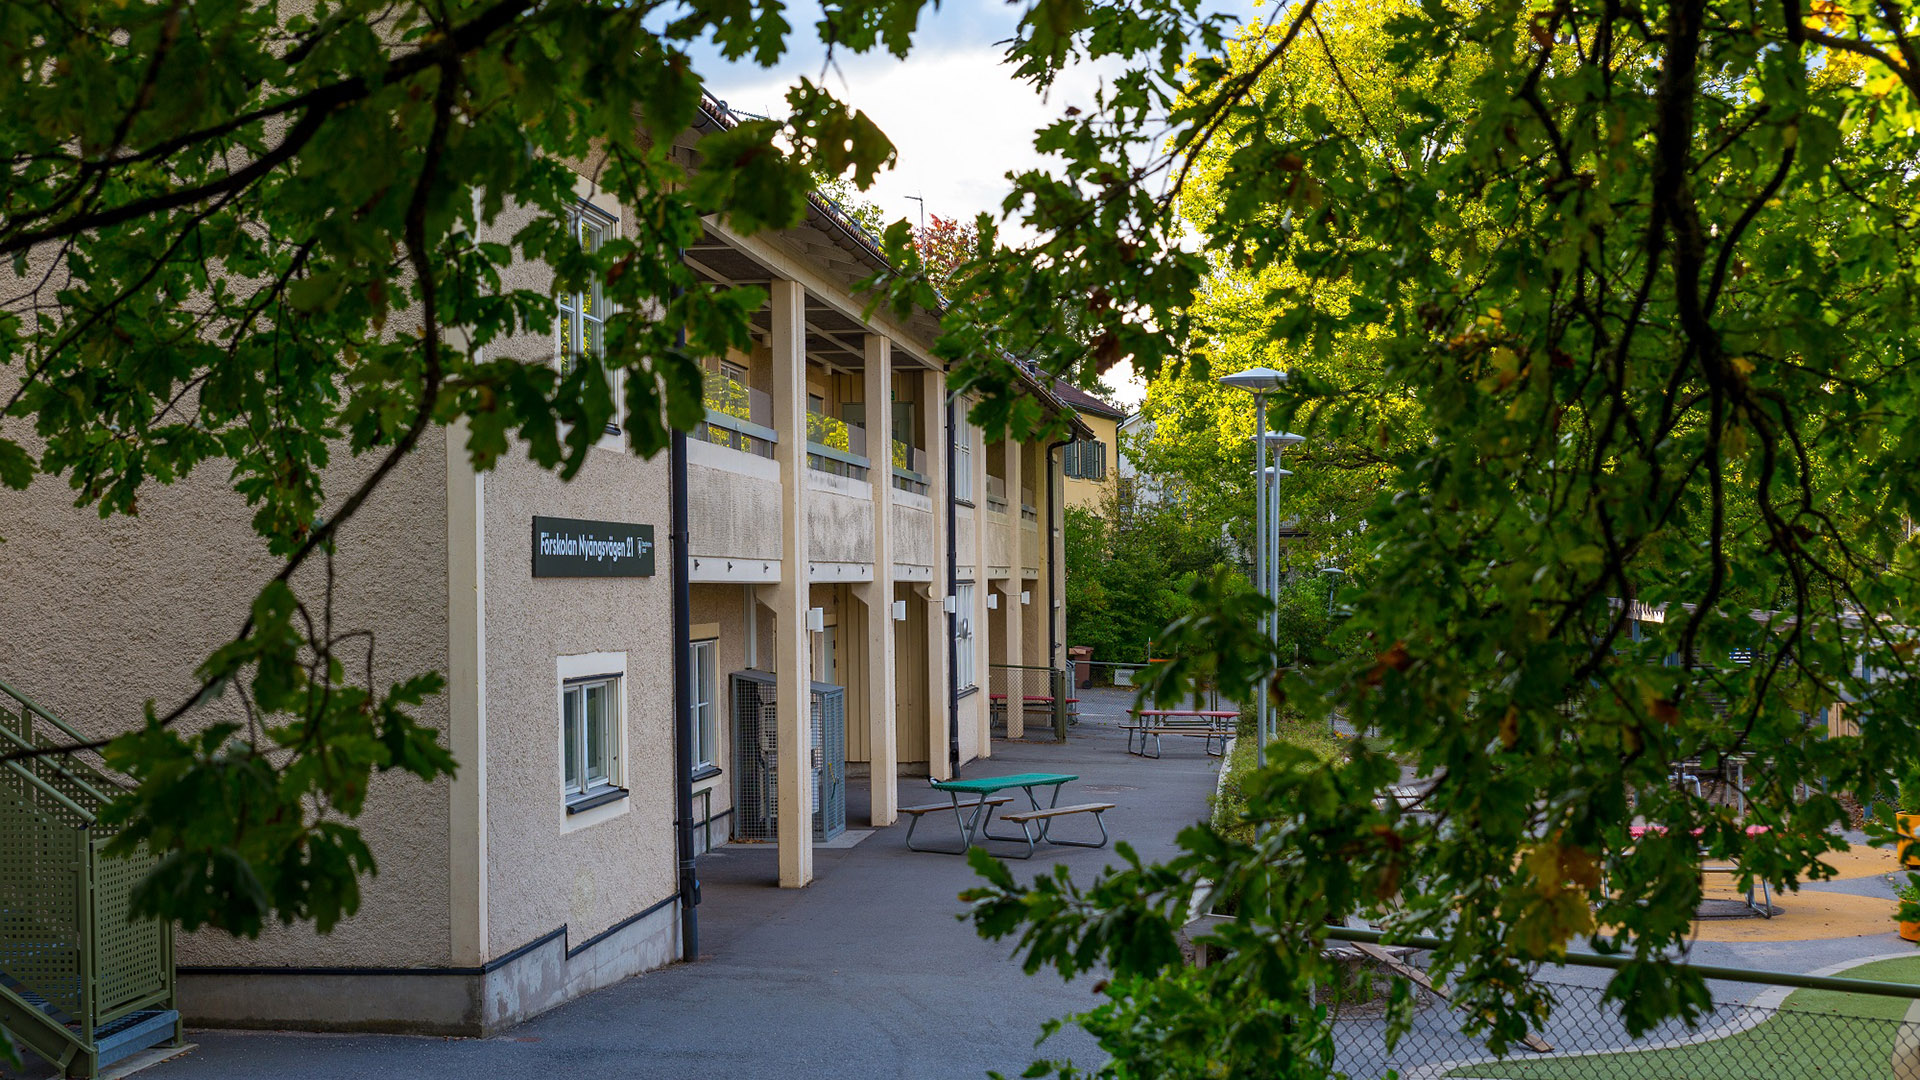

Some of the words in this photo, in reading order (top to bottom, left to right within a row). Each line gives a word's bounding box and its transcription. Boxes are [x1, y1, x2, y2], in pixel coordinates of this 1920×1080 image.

[540, 532, 577, 555] Förskolan
[579, 534, 625, 562] Nyängsvägen
[626, 536, 634, 557] 21
